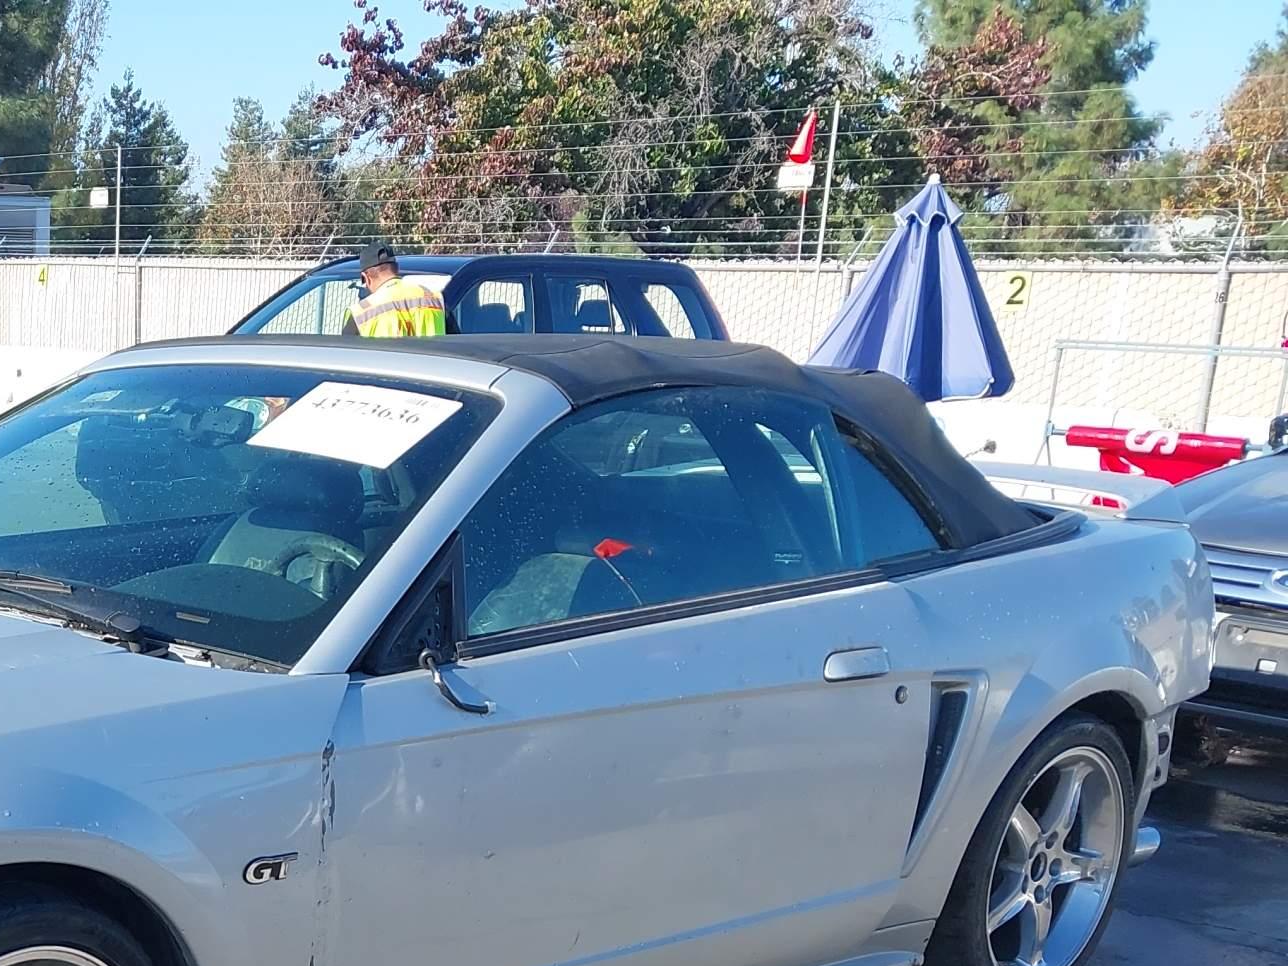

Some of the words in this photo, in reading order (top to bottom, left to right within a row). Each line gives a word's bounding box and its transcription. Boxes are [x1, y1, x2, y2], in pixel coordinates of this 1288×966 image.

[38, 267, 45, 286] 4
[1006, 276, 1027, 305] 2
[312, 397, 420, 425] 43773636
[243, 852, 298, 885] GT
